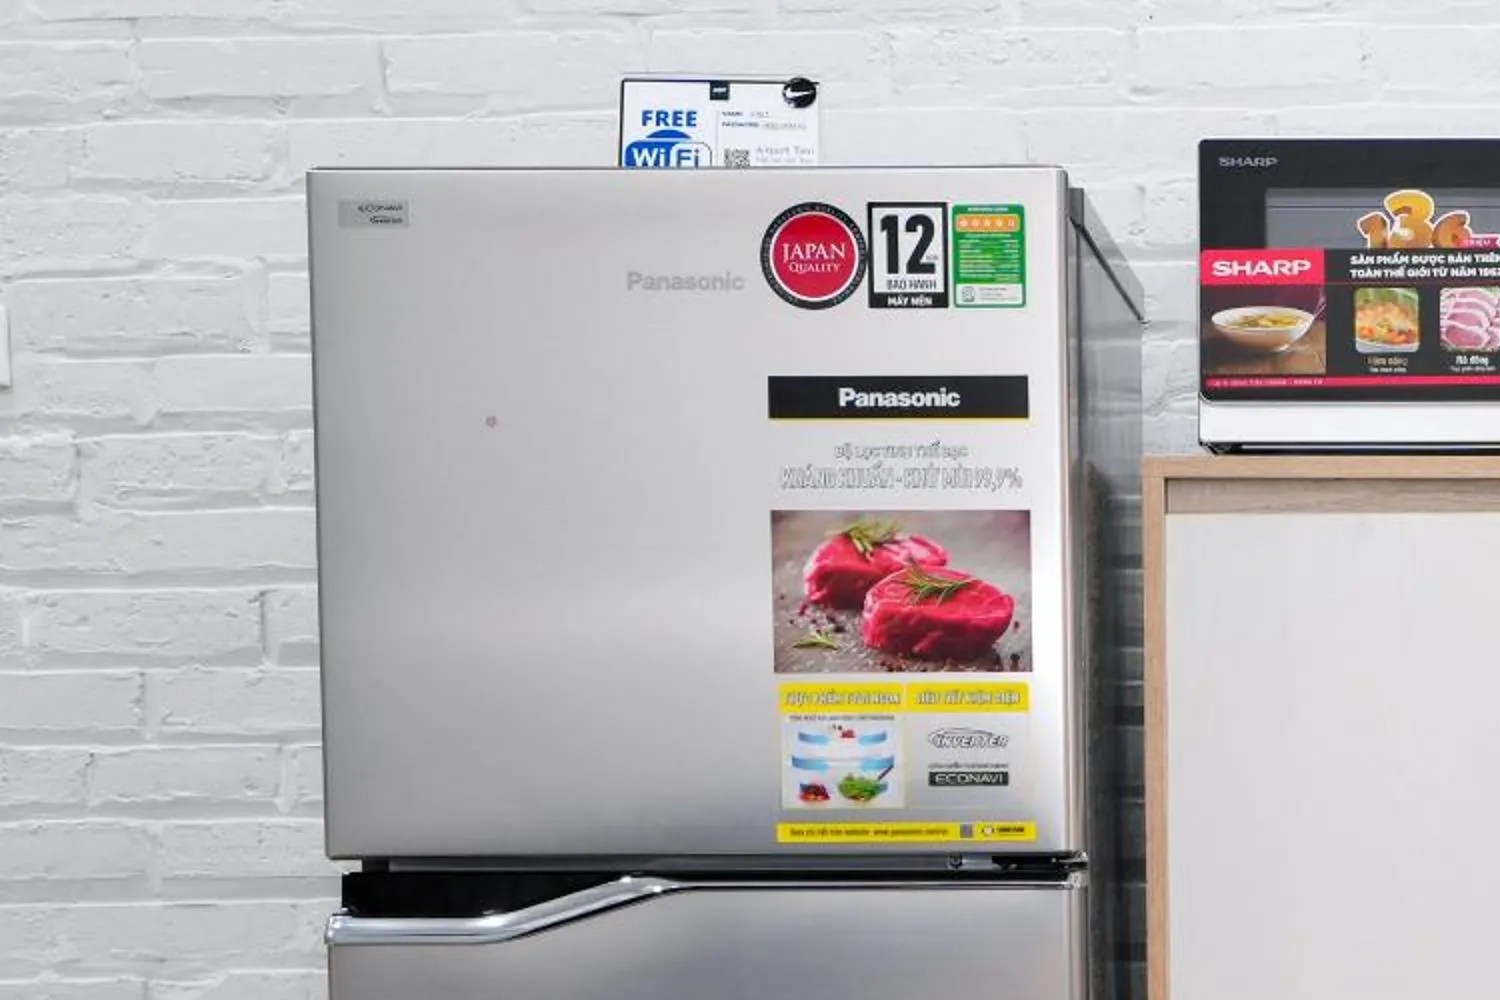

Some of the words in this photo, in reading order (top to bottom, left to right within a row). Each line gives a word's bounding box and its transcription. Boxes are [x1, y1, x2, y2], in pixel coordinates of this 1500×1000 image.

[641, 110, 698, 127] FREE
[1218, 156, 1278, 167] SHARP
[782, 242, 846, 263] JAPAN
[880, 213, 936, 275] 12
[788, 262, 841, 275] QUALITY
[1212, 259, 1312, 277] SHARP
[626, 271, 746, 292] Panasonic
[837, 386, 962, 408] Panasonic
[935, 773, 1004, 785] ECONAVI
